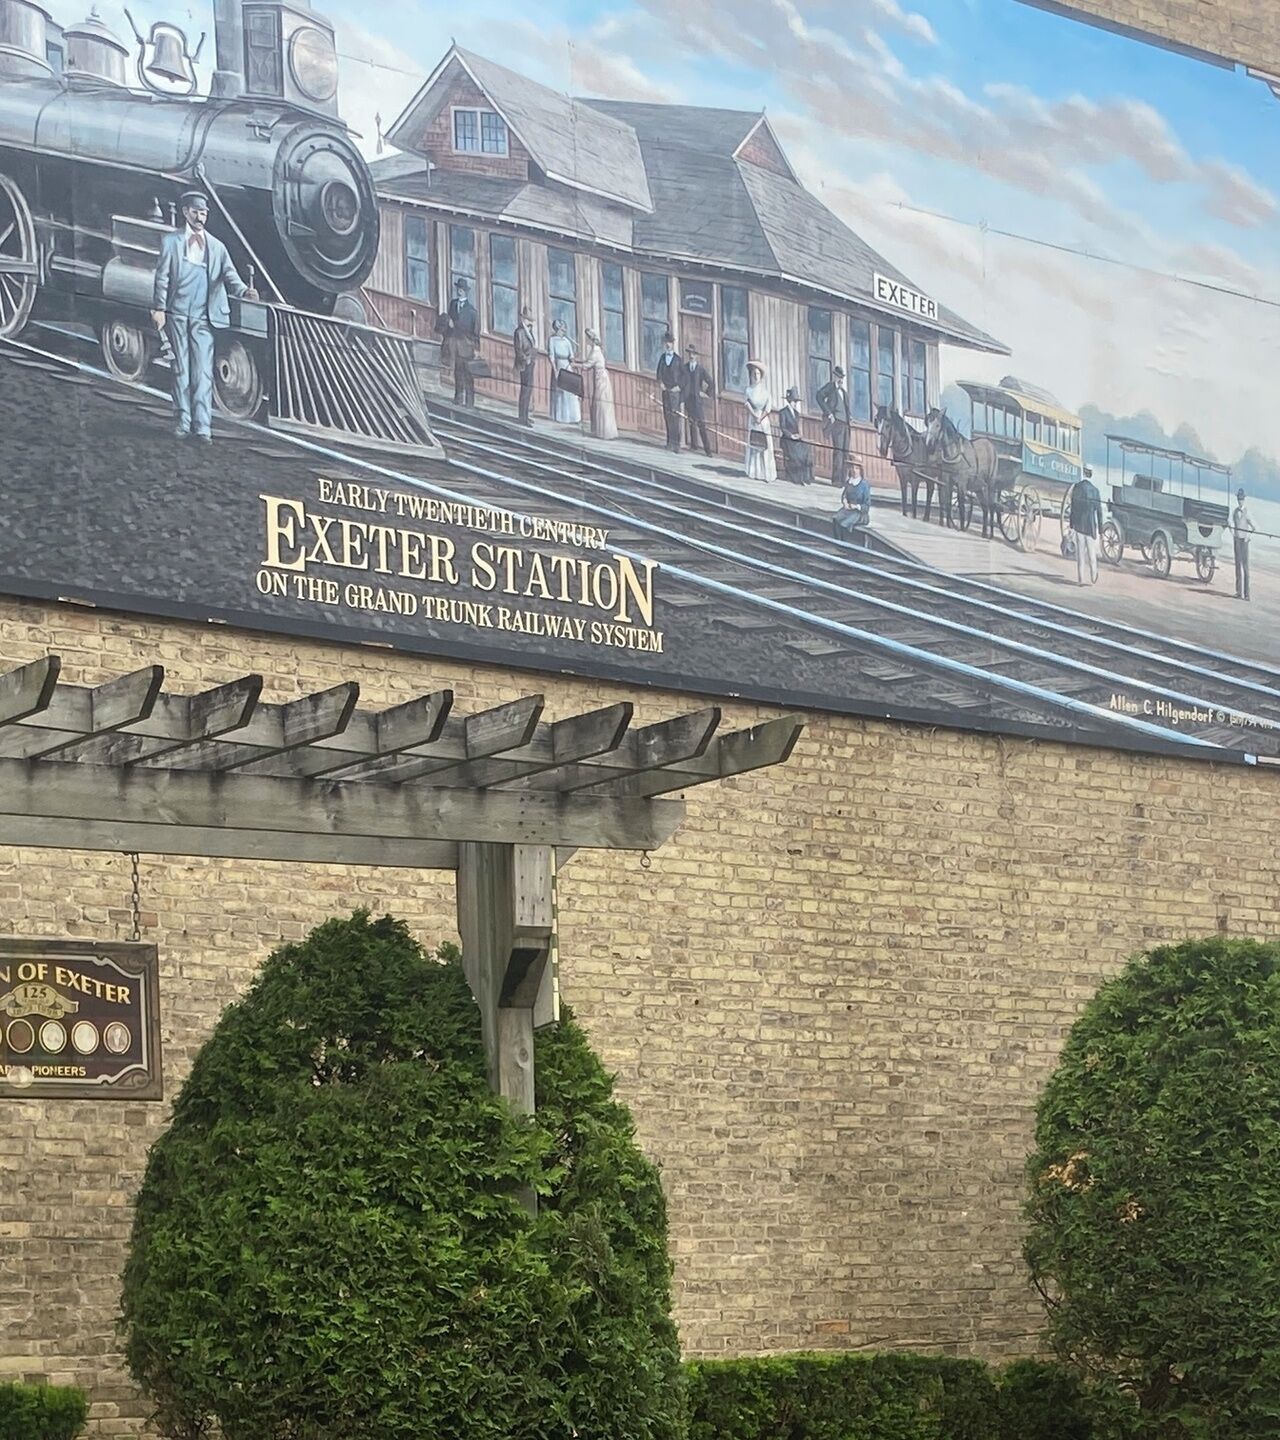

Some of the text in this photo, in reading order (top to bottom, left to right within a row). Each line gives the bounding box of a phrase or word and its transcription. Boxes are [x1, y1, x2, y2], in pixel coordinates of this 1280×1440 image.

[877, 278, 936, 319] EXETER
[317, 478, 610, 551] EARLY TWENTIETH CENTURY
[259, 494, 659, 627] EXETER STATION
[256, 570, 664, 653] ON THE GRAND TRUNK RAILWAY SYSTEM
[1110, 694, 1138, 712] Allen
[1156, 700, 1213, 724] Hilgendorf
[17, 962, 49, 981] OF
[55, 966, 131, 1005] EXETER
[23, 987, 47, 999] 125
[31, 1065, 86, 1077] PIONEERS
